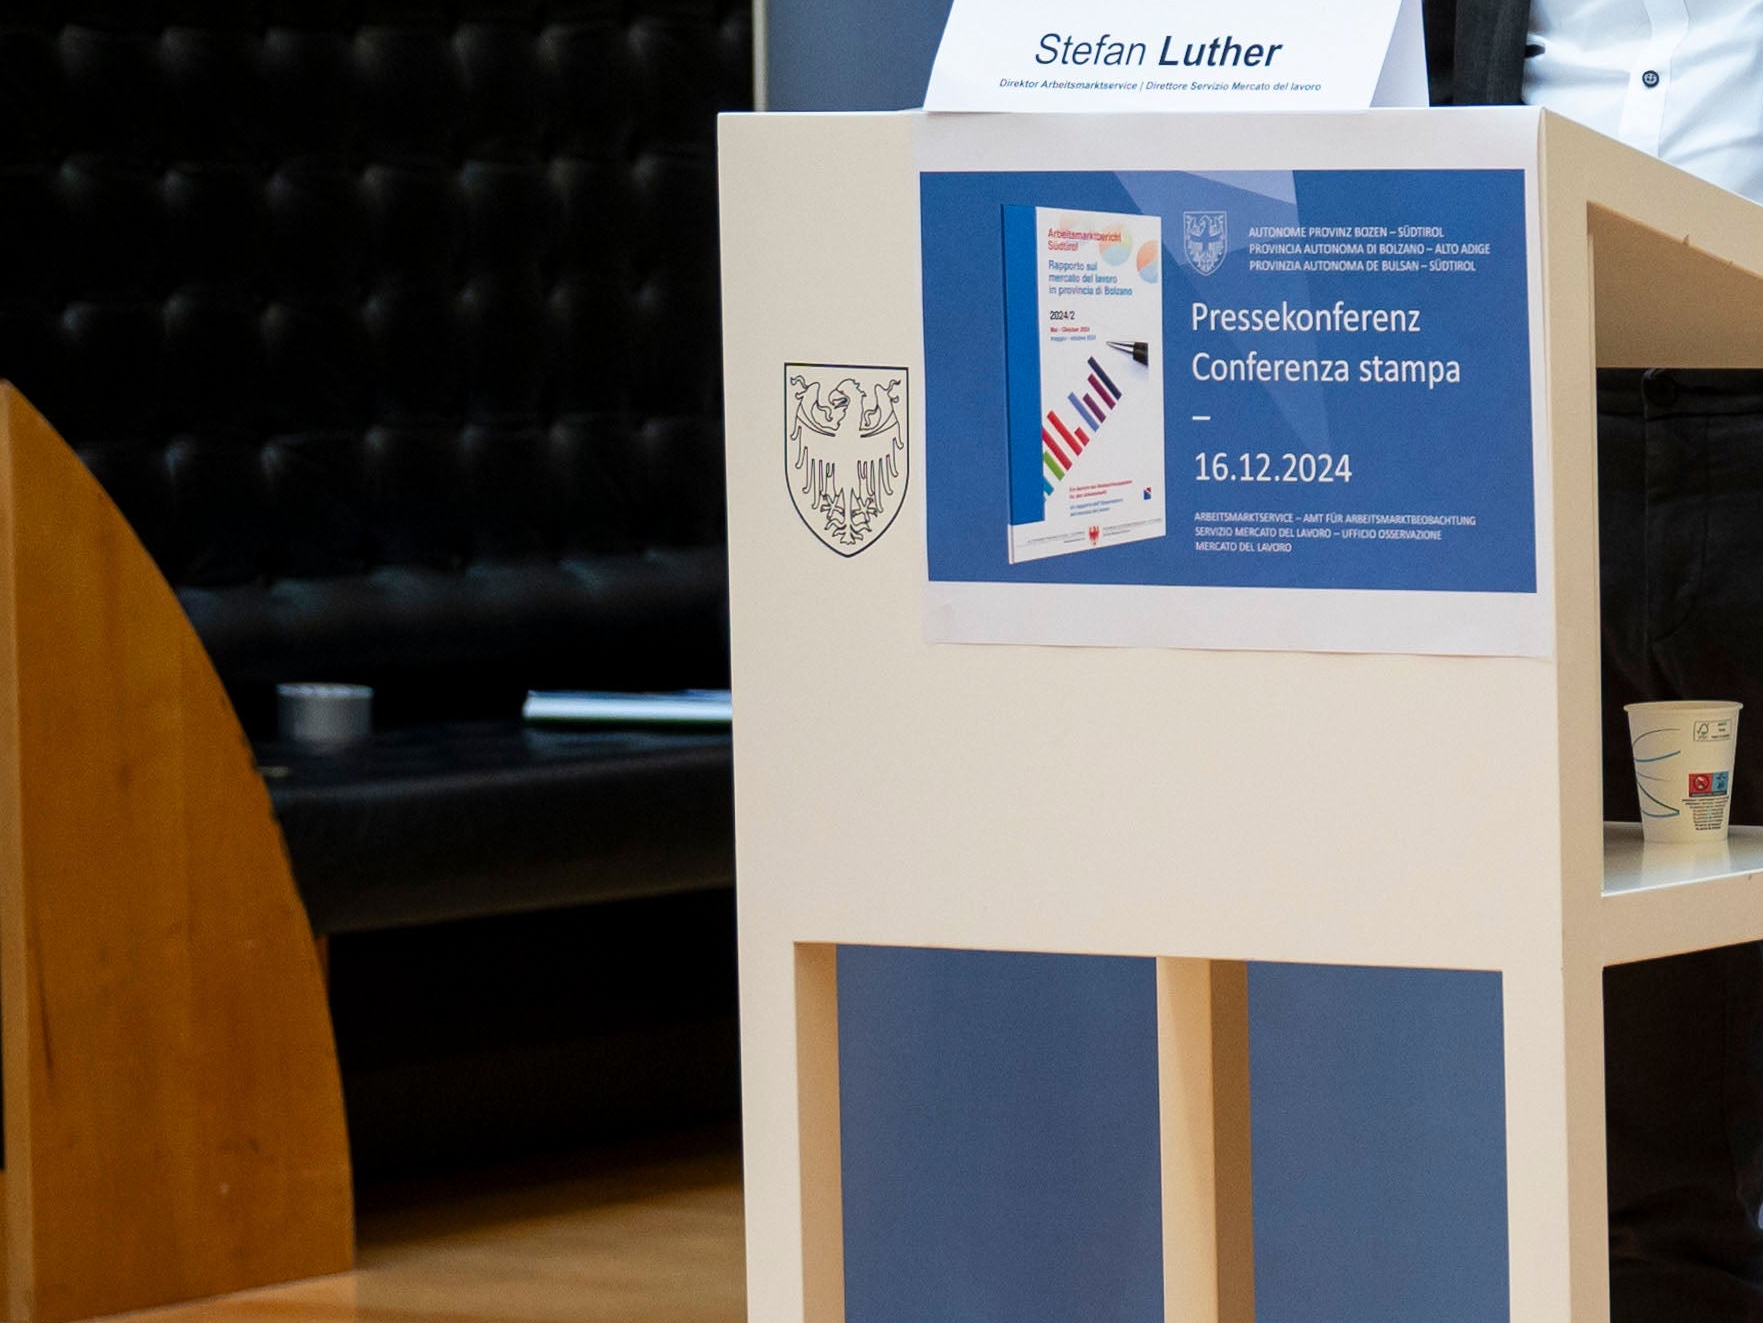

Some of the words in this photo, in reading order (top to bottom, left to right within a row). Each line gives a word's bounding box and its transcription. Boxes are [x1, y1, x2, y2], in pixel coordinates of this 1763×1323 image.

[1035, 32, 1147, 66] Stefan
[1158, 34, 1284, 67] Luther
[1000, 78, 1039, 89] Direktor
[1040, 79, 1137, 91] Arbeitsmarktservice
[1146, 81, 1188, 91] Direttore
[1190, 82, 1229, 91] Servizio
[1231, 82, 1270, 91] Mercato
[1273, 83, 1288, 91] del
[1291, 83, 1322, 92] lavoro
[1249, 227, 1306, 237] AUTONOME
[1309, 227, 1352, 237] PROVINZ
[1354, 227, 1388, 238] BOZEN
[1398, 224, 1445, 238] SÜDTIROL
[1249, 244, 1302, 254] PROVINCIA
[1304, 244, 1364, 255] AUTONOMA
[1366, 244, 1377, 255] DI
[1379, 244, 1424, 255] BOLZANO
[1434, 244, 1459, 255] ALTO
[1461, 244, 1491, 255] ADIGE
[1249, 260, 1301, 271] PROVINZIA
[1303, 260, 1364, 271] AUTONOMA
[1366, 261, 1379, 271] DE
[1381, 260, 1419, 271] BULSAN
[1429, 258, 1476, 272] SÜDTIROL
[1191, 300, 1421, 332] Pressekonferenz
[1191, 350, 1350, 382] Conferenza
[1358, 355, 1461, 390] stampa
[1194, 452, 1353, 483] 16.12.2024
[1303, 513, 1324, 523] AMT
[1326, 510, 1343, 524] FÜR
[1194, 527, 1233, 537] SERVIZIO
[1235, 527, 1276, 538] MERCATO
[1279, 528, 1295, 538] DEL
[1297, 528, 1332, 539] LAVORO
[1195, 542, 1237, 552] MERCATO
[1239, 542, 1255, 552] DEL
[1257, 543, 1292, 553] LAVORO
